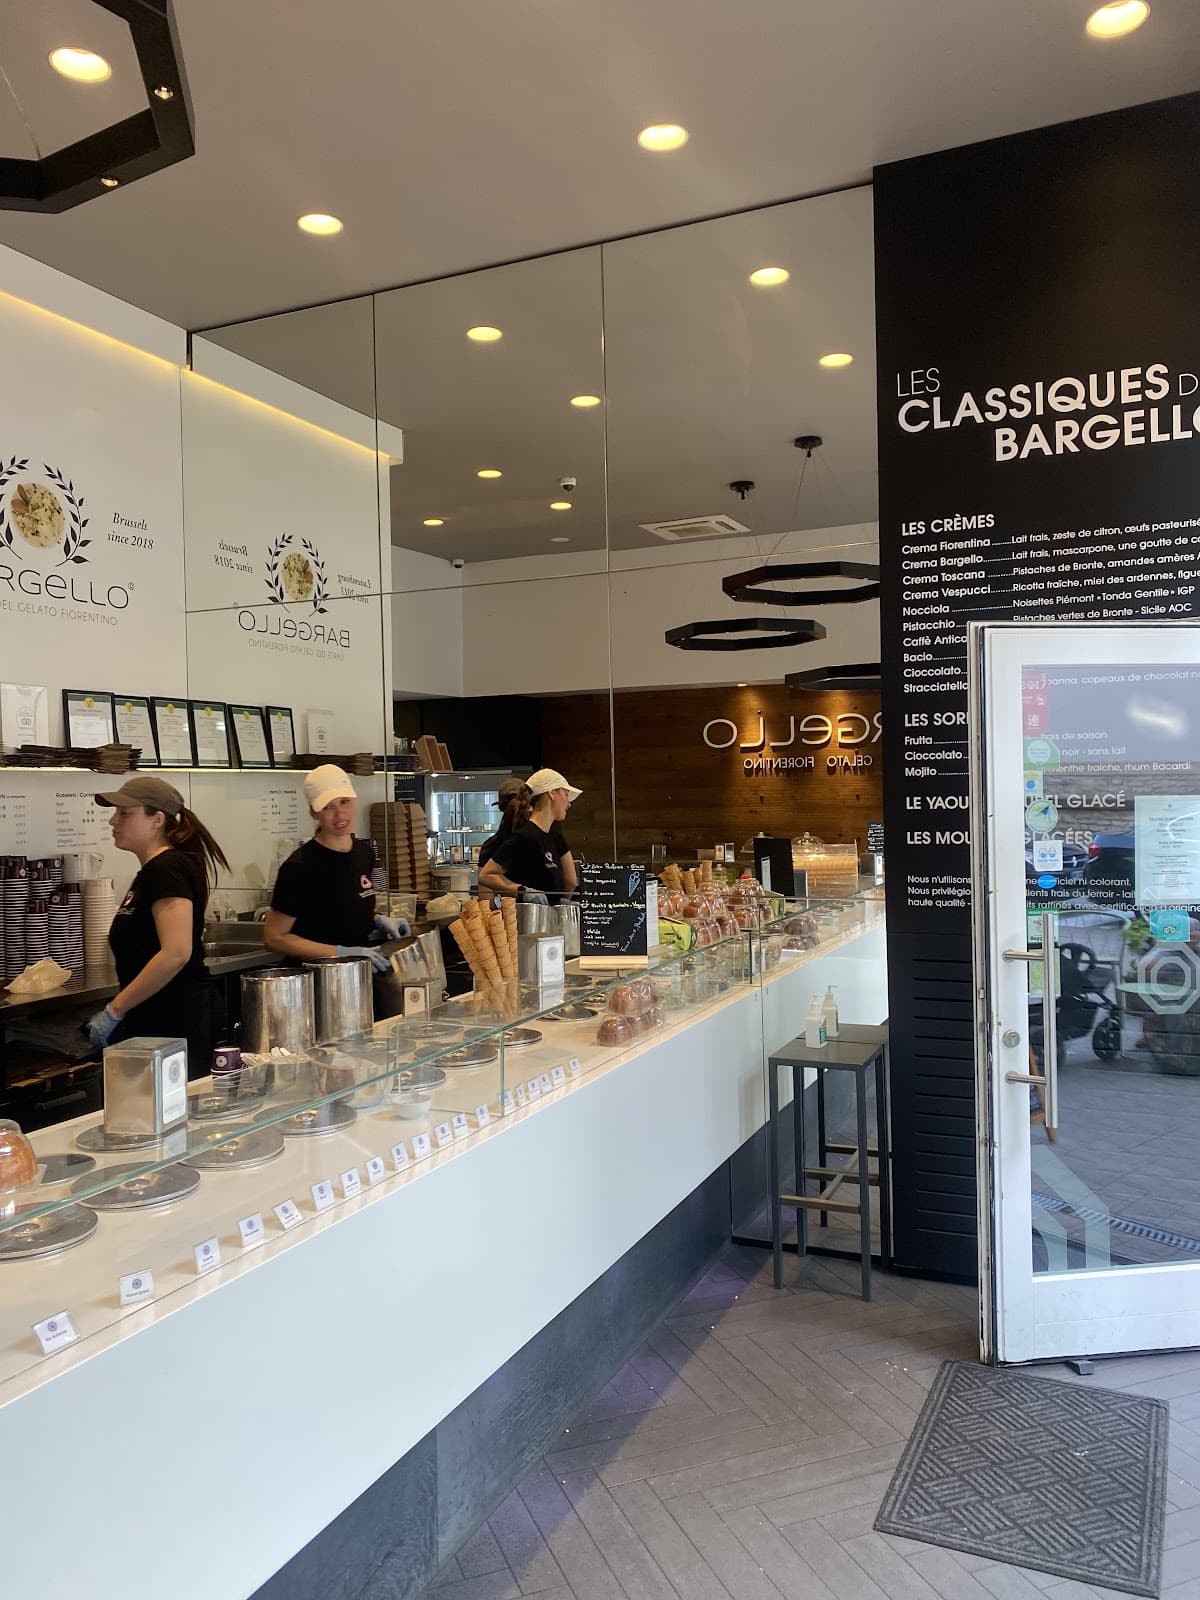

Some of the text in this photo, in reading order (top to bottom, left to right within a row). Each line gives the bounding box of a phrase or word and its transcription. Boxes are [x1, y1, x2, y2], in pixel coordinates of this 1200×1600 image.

[897, 368, 940, 396] LES
[898, 363, 1170, 433] CLASSIQUES
[995, 404, 1200, 462] BARGELL
[112, 512, 149, 531] Brussels
[902, 514, 995, 536] LES CRÈMES
[106, 530, 154, 550] since 2018
[902, 544, 938, 555] Crema
[940, 538, 991, 551] Fiorentina
[1012, 535, 1028, 545] Lait
[1030, 533, 1051, 542] frais,
[1053, 531, 1076, 540] zeste
[1078, 529, 1092, 538] de
[1094, 526, 1123, 536] citron,
[902, 560, 938, 570] Crema
[940, 554, 984, 567] Bargello
[1012, 551, 1028, 560] Lait
[1030, 549, 1051, 558] frais,
[1053, 544, 1116, 557] mascarpone,
[1118, 541, 1137, 550] une
[1140, 538, 1172, 550] goutte
[1175, 535, 1189, 545] de
[903, 575, 938, 585] Crema
[941, 570, 985, 582] Toscana
[1013, 565, 1056, 576] Pistaches
[1058, 562, 1071, 572] de
[1073, 559, 1106, 570] Bronte,
[1107, 557, 1155, 568] amandes
[1157, 552, 1195, 564] amères
[903, 590, 939, 601] Crema
[941, 584, 991, 598] Vespucci
[1013, 581, 1045, 592] Ricotta
[1084, 575, 1105, 586] miel
[1107, 574, 1125, 585] des
[1127, 570, 1176, 583] ardennes,
[903, 604, 950, 616] Nocciola
[1013, 597, 1054, 608] Noisettes
[1056, 594, 1095, 605] Piémont
[1177, 585, 1195, 595] IGP
[0, 600, 118, 626] EL GELATO FIORENTINO
[903, 619, 956, 631] Pistacchio
[1057, 610, 1086, 620] vertes
[1087, 609, 1100, 618] de
[1102, 606, 1133, 618] Bronte
[1141, 605, 1167, 615] Sicile
[1168, 602, 1193, 613] AOC
[903, 636, 932, 647] Caffè
[903, 652, 933, 663] Bacio
[903, 666, 961, 678] Cioccolato
[1081, 675, 1125, 685] copeaux
[1127, 673, 1141, 682] de
[1143, 671, 1189, 681] chocolat
[904, 711, 968, 727] LES SOR
[904, 735, 933, 746] Frutta
[1062, 731, 1076, 740] de
[1077, 730, 1108, 740] saison
[904, 750, 963, 761] Cioccolato
[1062, 748, 1080, 756] noir
[1087, 748, 1110, 756] sans
[904, 766, 938, 778] Mojito
[1125, 763, 1150, 772] rhum
[1152, 760, 1191, 771] Bacardi
[906, 796, 921, 810] LE
[1067, 790, 1126, 808] GLACÉ
[906, 831, 931, 845] LES
[908, 875, 930, 884] Nous
[1089, 877, 1131, 886] colorant.
[908, 886, 930, 895] Nous
[1051, 889, 1071, 898] frais
[908, 897, 933, 907] haute
[935, 898, 966, 908] qualité
[1074, 902, 1099, 911] avec
